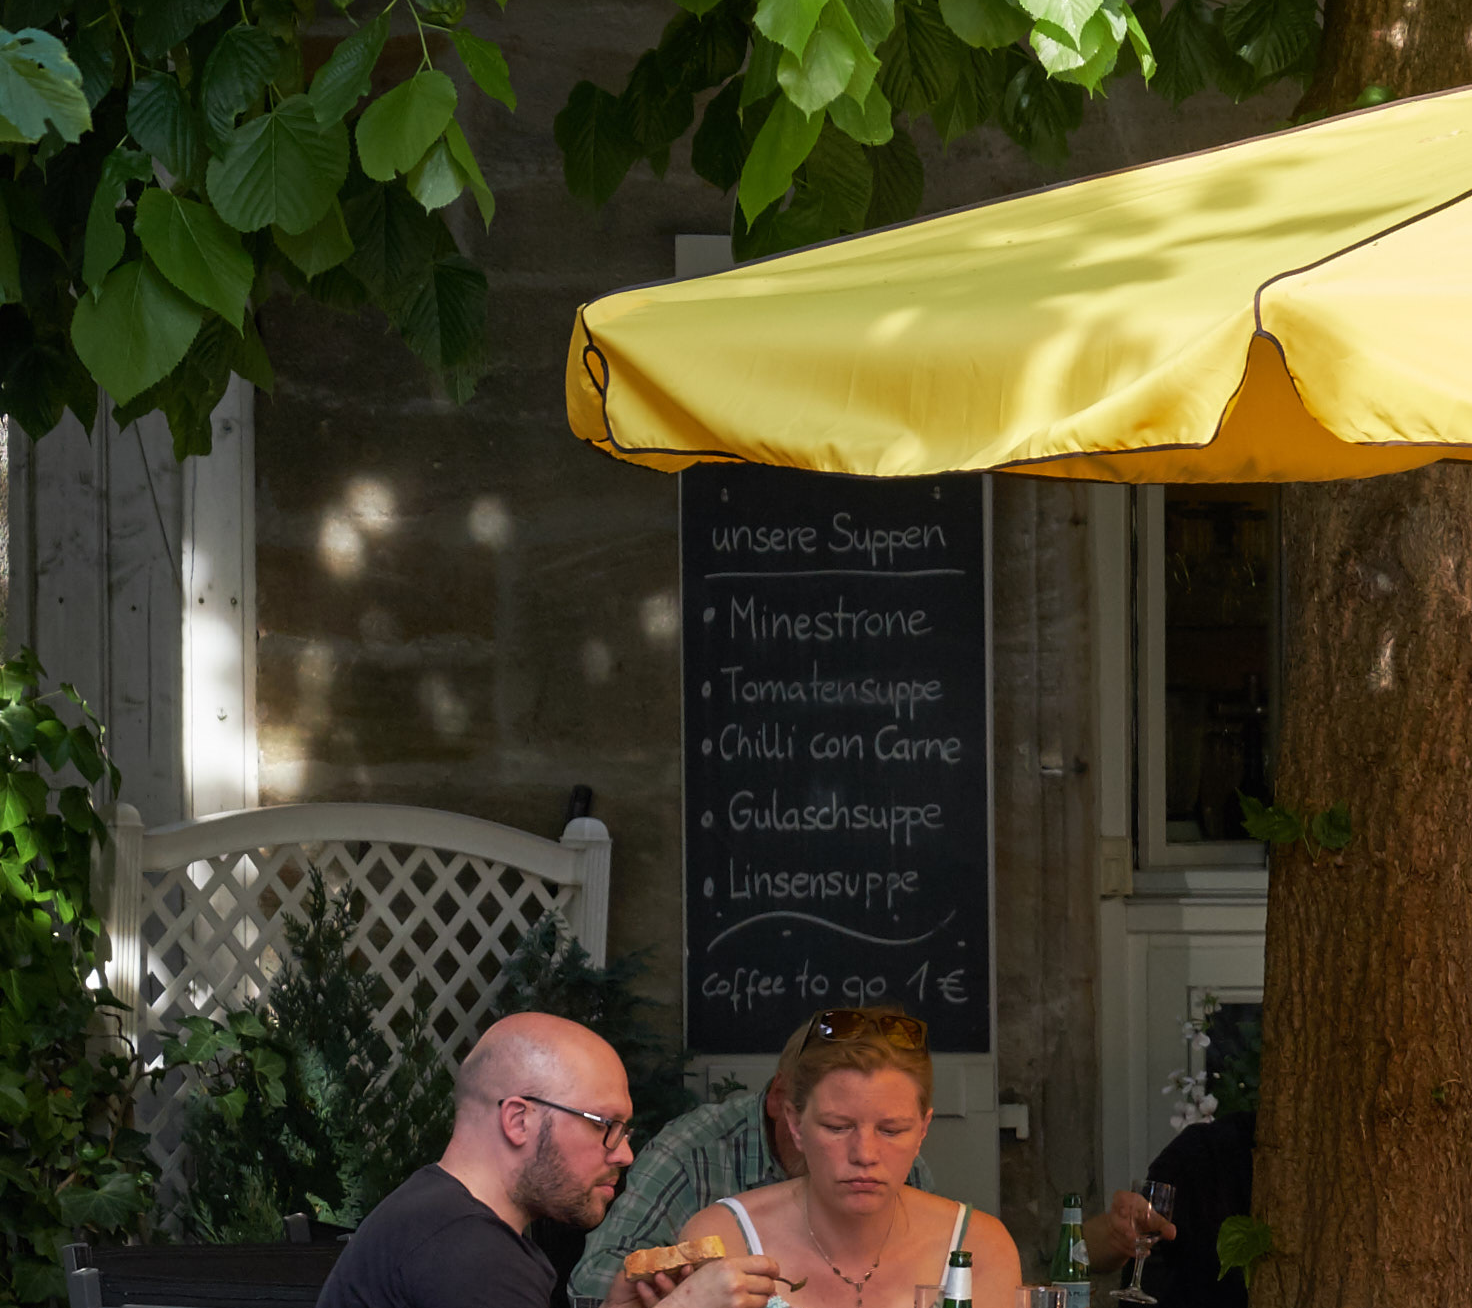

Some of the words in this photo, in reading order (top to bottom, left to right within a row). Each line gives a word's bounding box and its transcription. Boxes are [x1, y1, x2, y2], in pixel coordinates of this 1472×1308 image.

[712, 524, 817, 554] unsere
[827, 512, 947, 566] Suppen
[730, 596, 933, 642] Minestrone
[719, 660, 944, 720] Tomatensuppe
[719, 723, 795, 762] Chilli
[809, 731, 864, 760] con
[873, 726, 962, 764] Carne
[727, 790, 945, 847] Gulaschsuppe
[730, 857, 919, 909] Linsensuppe
[702, 967, 787, 1012] coffee
[795, 959, 829, 999] to
[841, 976, 888, 1007] go
